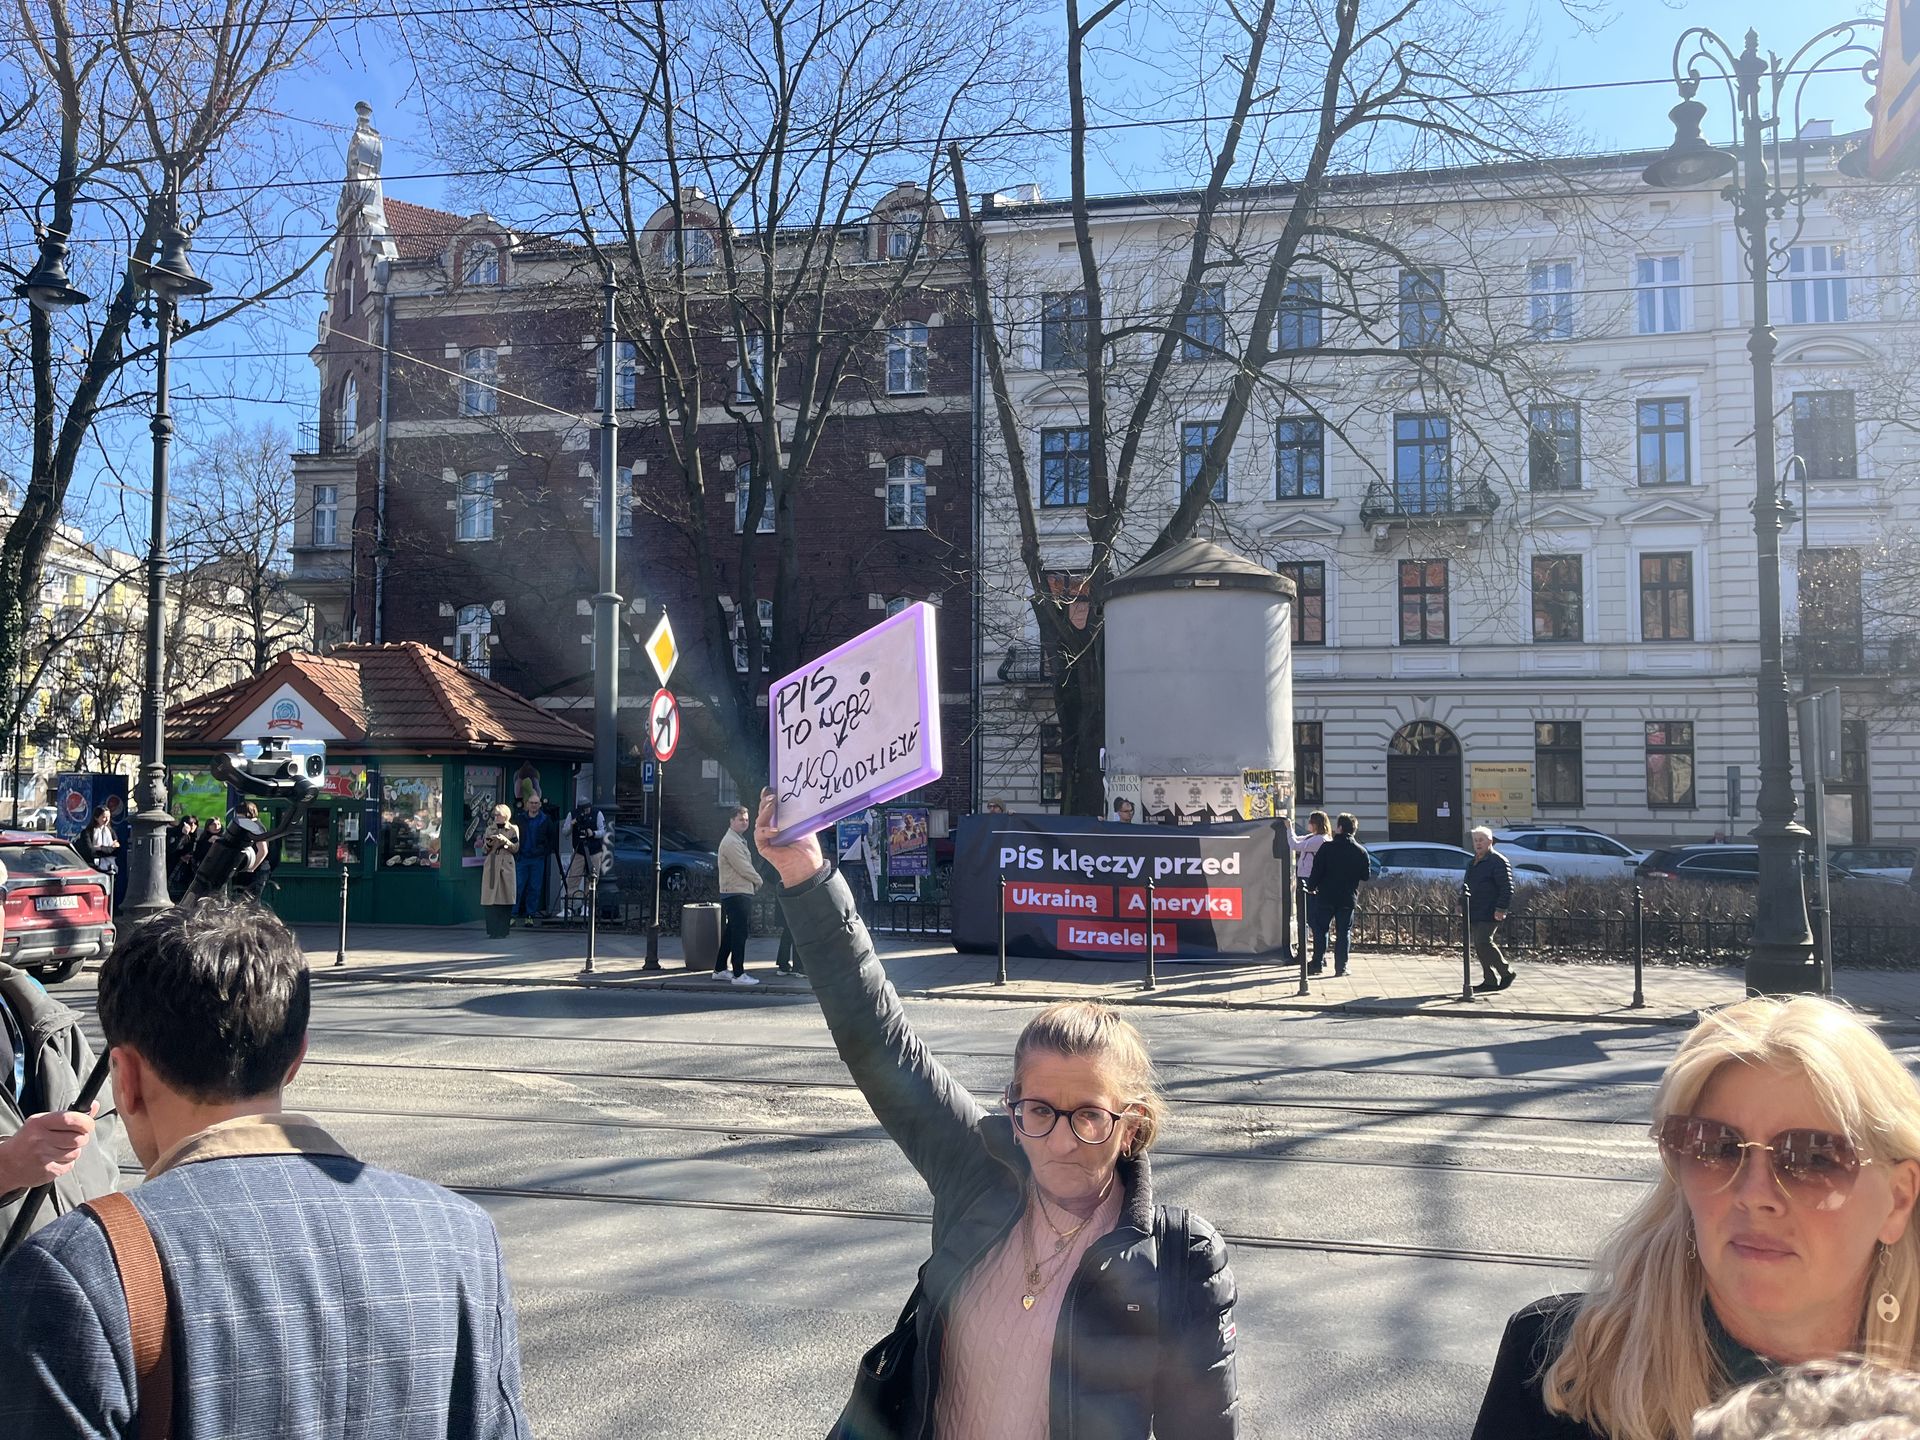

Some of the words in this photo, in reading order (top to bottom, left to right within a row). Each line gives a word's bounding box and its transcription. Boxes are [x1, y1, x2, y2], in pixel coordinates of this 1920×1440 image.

[776, 666, 837, 726] PIS
[782, 718, 812, 750] TO
[1000, 845, 1044, 870] PiS
[1052, 848, 1145, 879] klęczy
[1154, 852, 1240, 879] przed
[1012, 888, 1098, 913] Ukrainą
[1128, 894, 1233, 917] Ameryką
[1068, 927, 1165, 947] Izraelem
